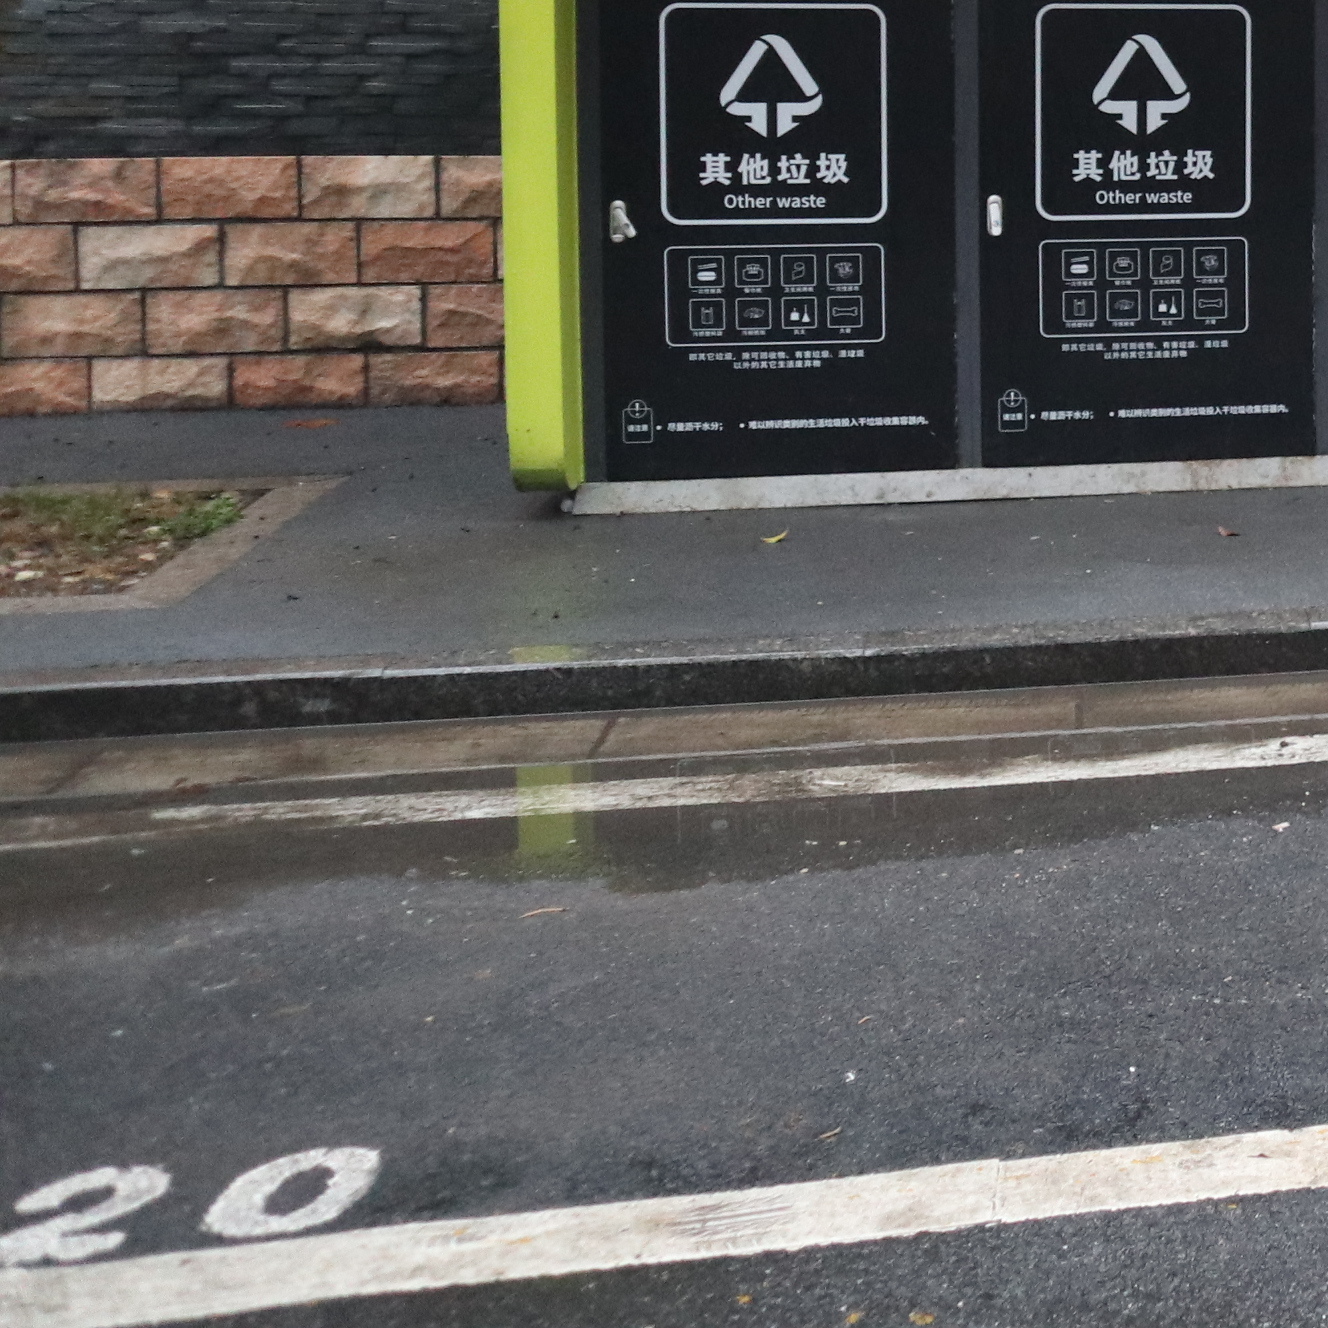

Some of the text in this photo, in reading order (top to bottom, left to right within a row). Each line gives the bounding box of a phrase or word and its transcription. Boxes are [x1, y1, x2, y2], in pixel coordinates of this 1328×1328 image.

[698, 152, 850, 186] 其他垃圾
[1072, 148, 1215, 182] 其他垃圾
[723, 193, 827, 209] Other waste
[1095, 189, 1193, 205] Other waste
